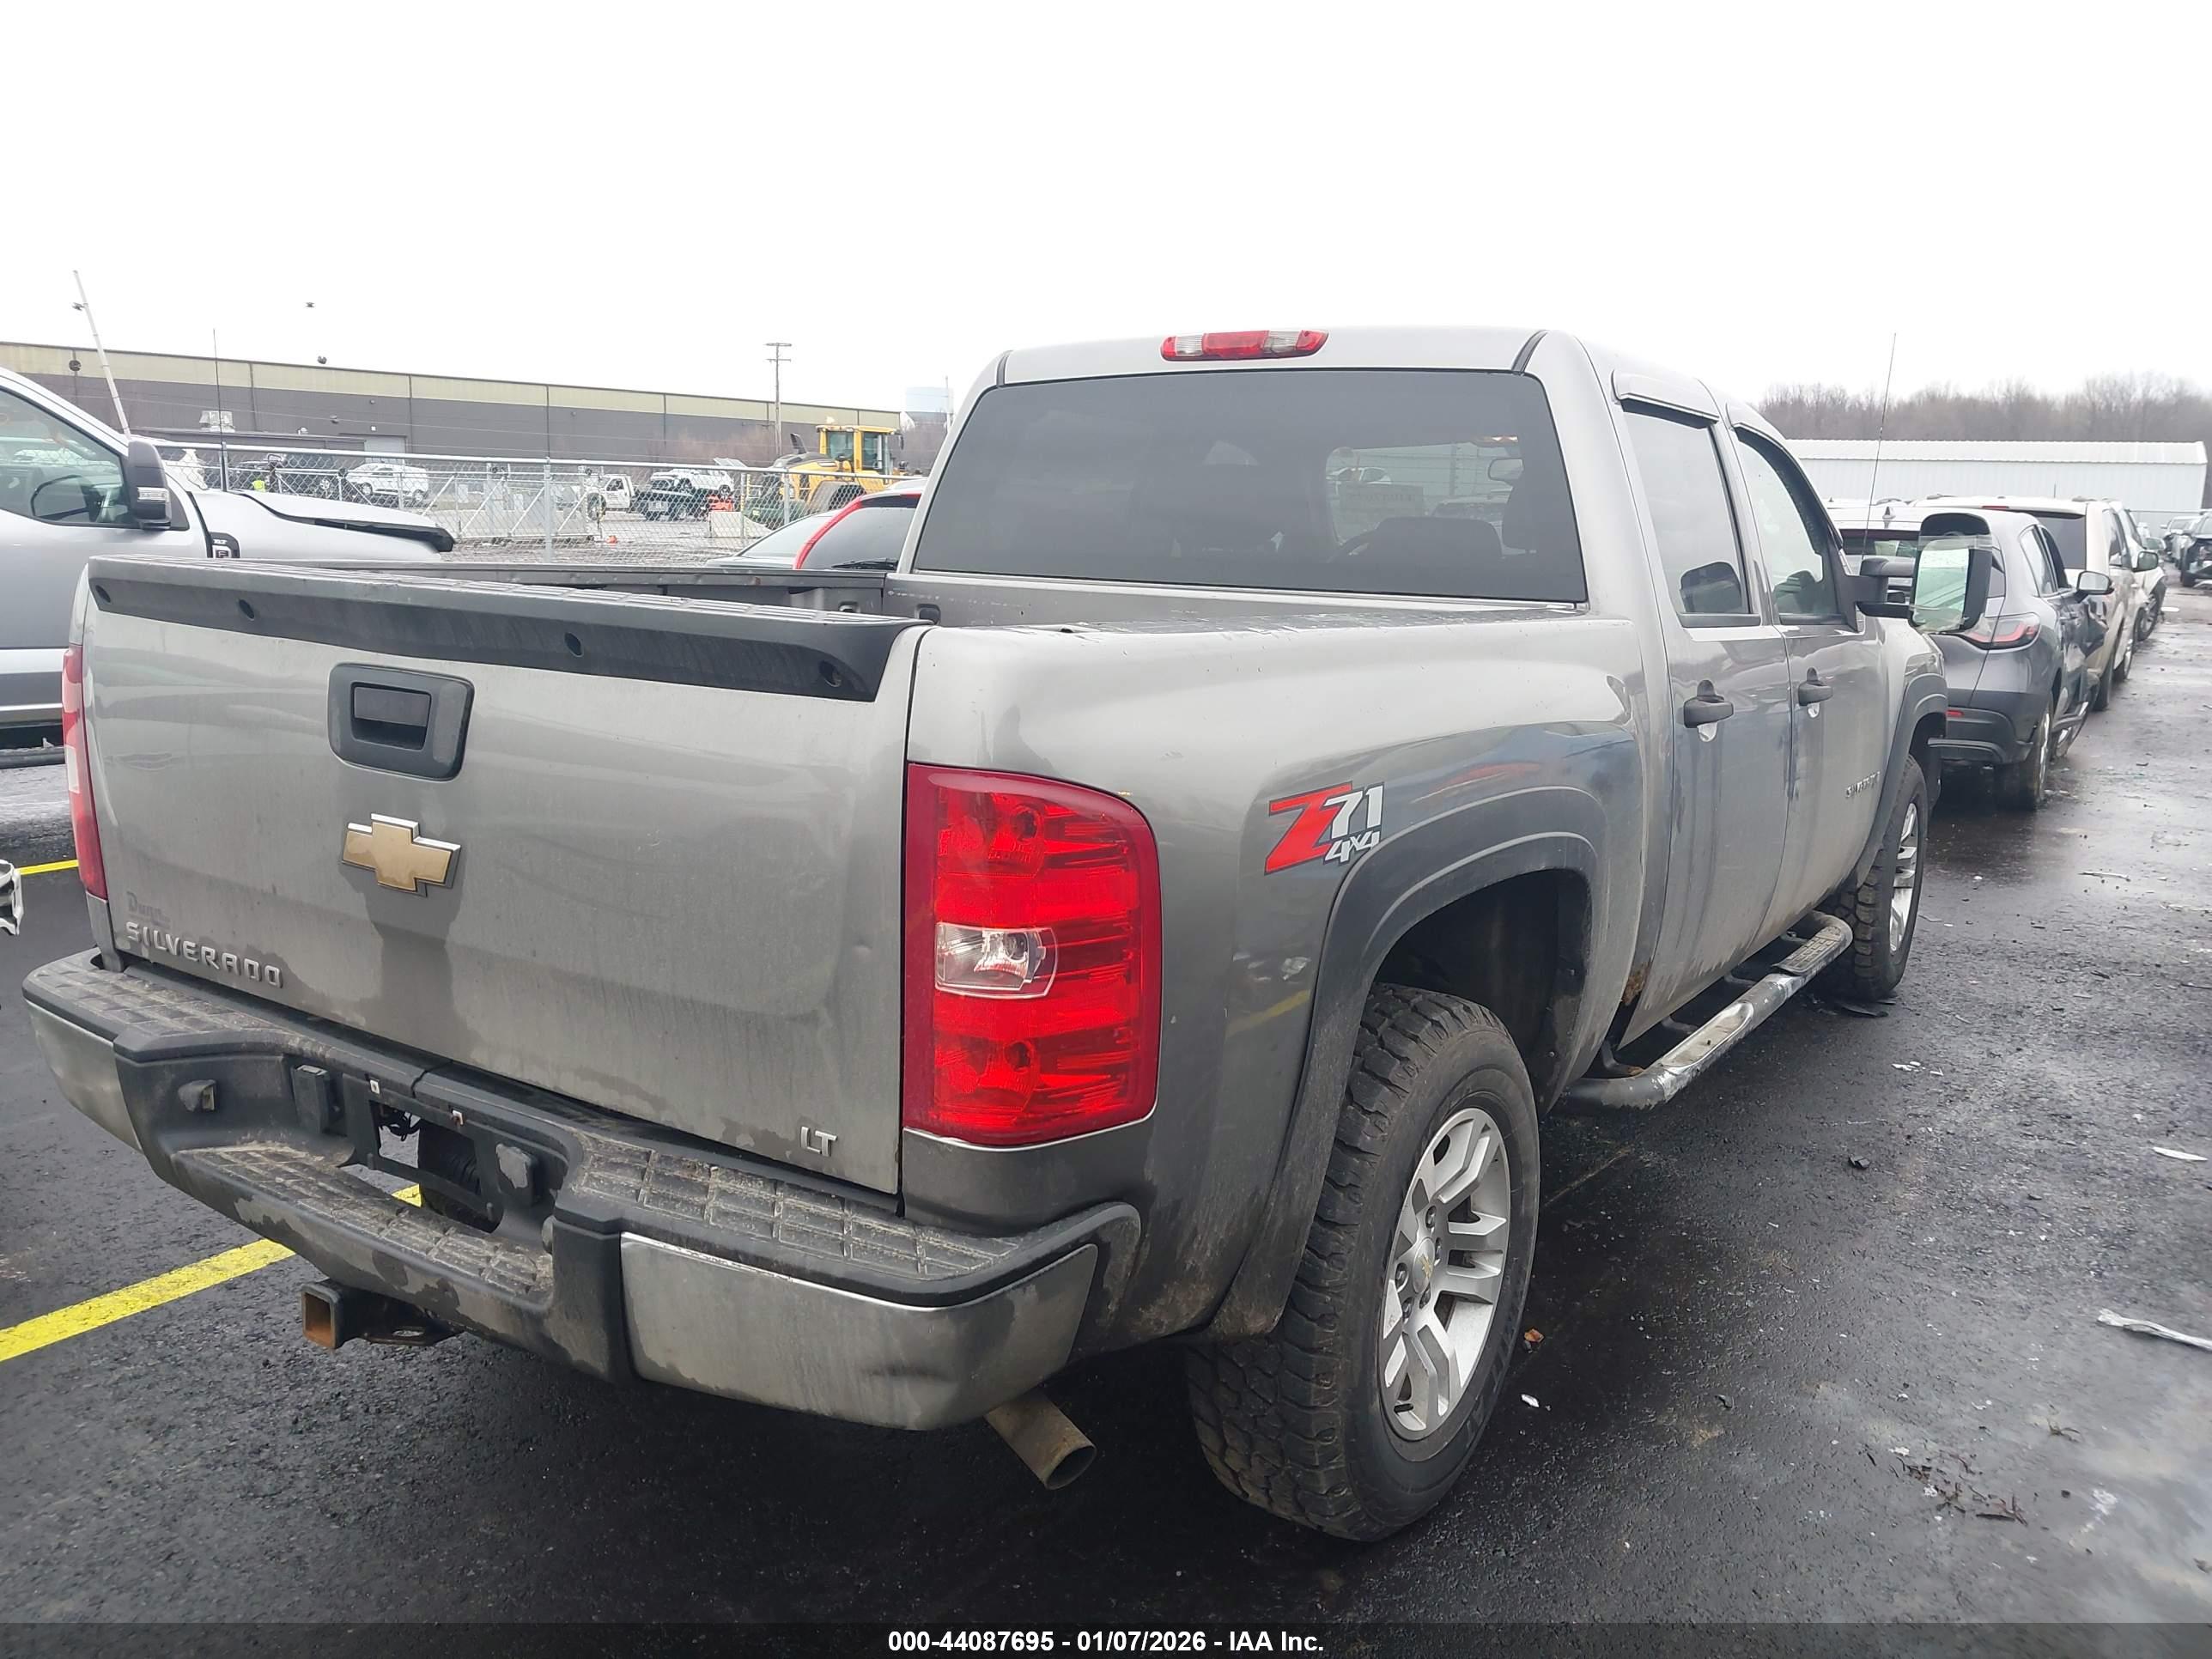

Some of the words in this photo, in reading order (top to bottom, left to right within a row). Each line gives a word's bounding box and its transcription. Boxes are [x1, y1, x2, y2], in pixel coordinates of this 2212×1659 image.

[1264, 780, 1384, 875] Z71
[125, 921, 283, 989] SILVERADO
[800, 1126, 838, 1157] LT
